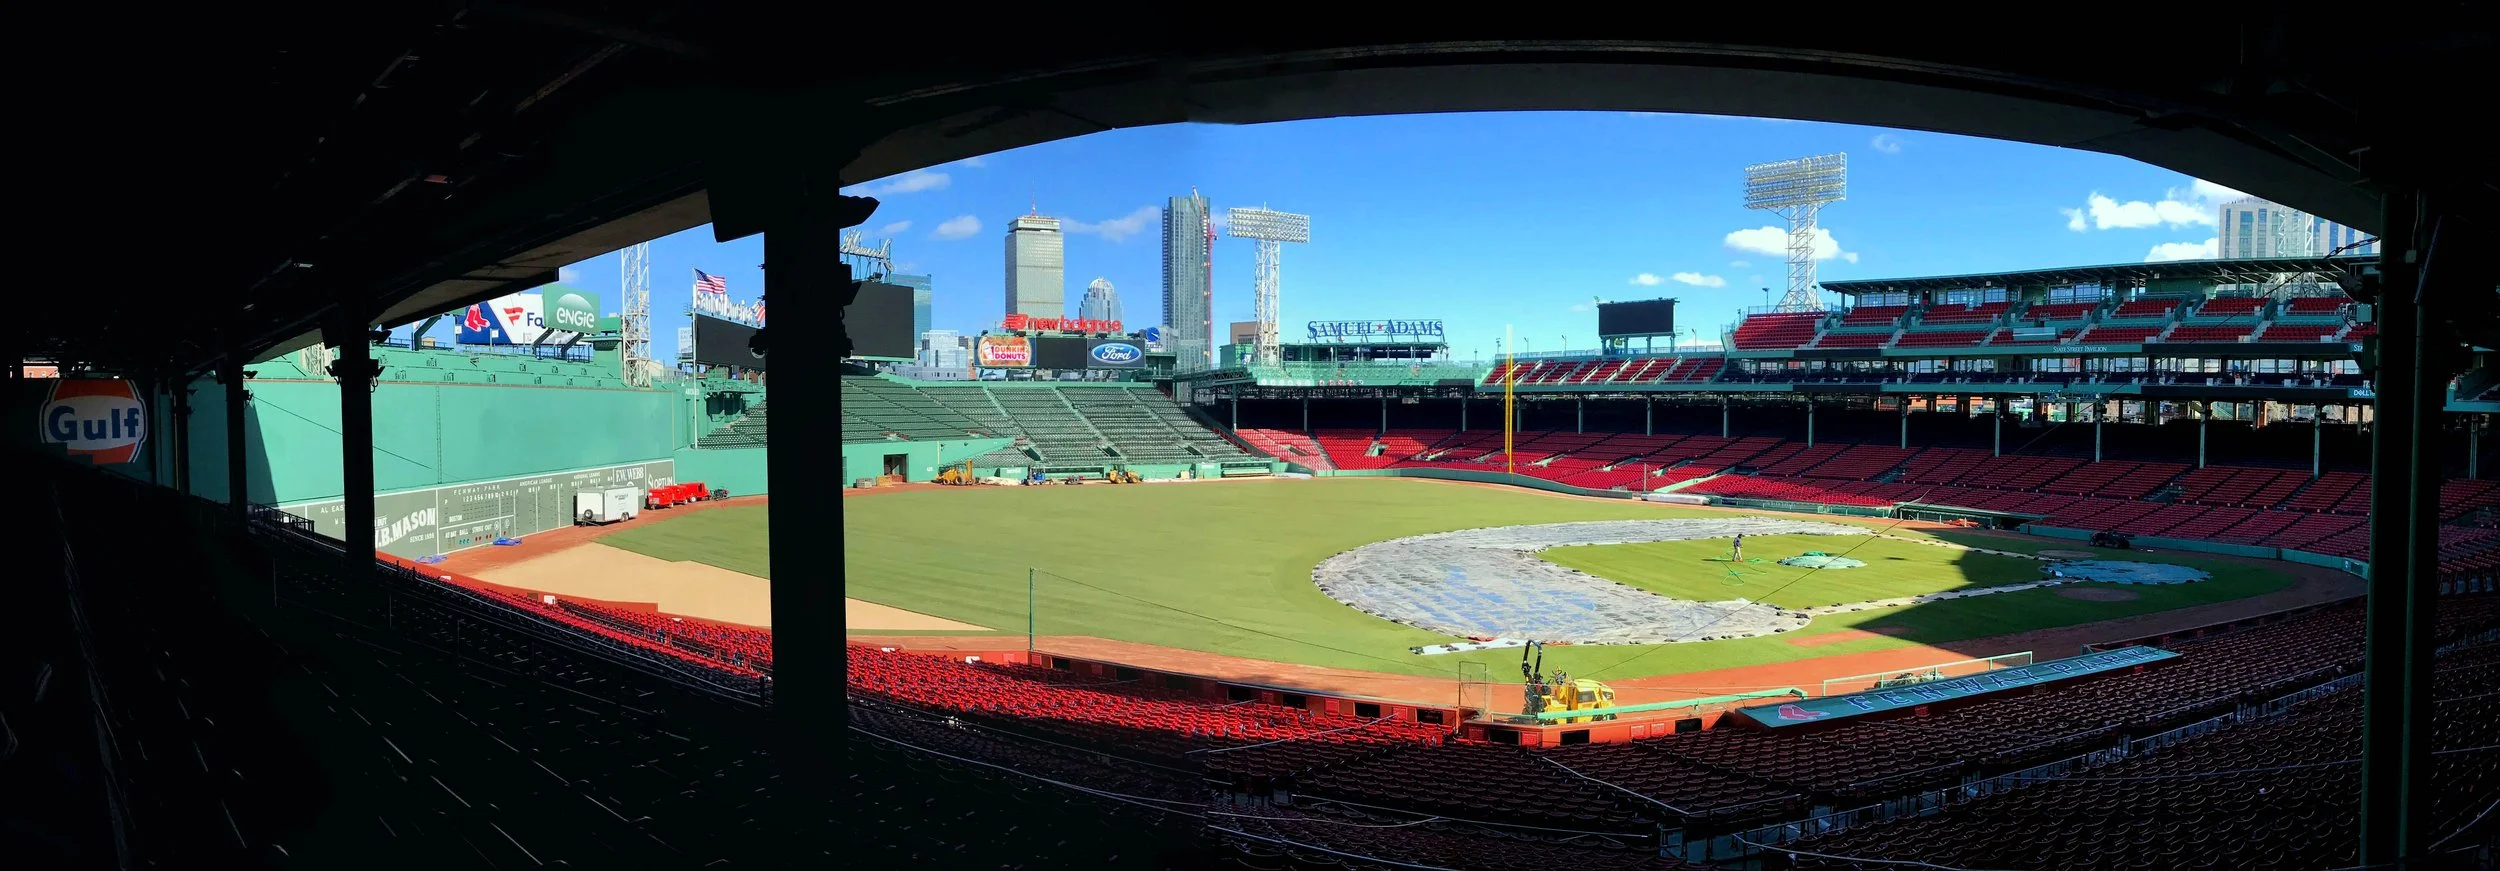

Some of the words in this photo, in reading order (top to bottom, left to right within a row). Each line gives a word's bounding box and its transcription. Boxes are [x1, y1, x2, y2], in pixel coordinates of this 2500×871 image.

[1028, 317, 1060, 332] new
[1060, 315, 1122, 334] balance
[1307, 320, 1375, 339] SAMUEL
[1385, 319, 1443, 337] ADAMS
[1101, 346, 1132, 361] Ford
[48, 405, 139, 441] Gulf
[1845, 668, 2043, 711] FENWAY
[2044, 648, 2149, 676] PARK
